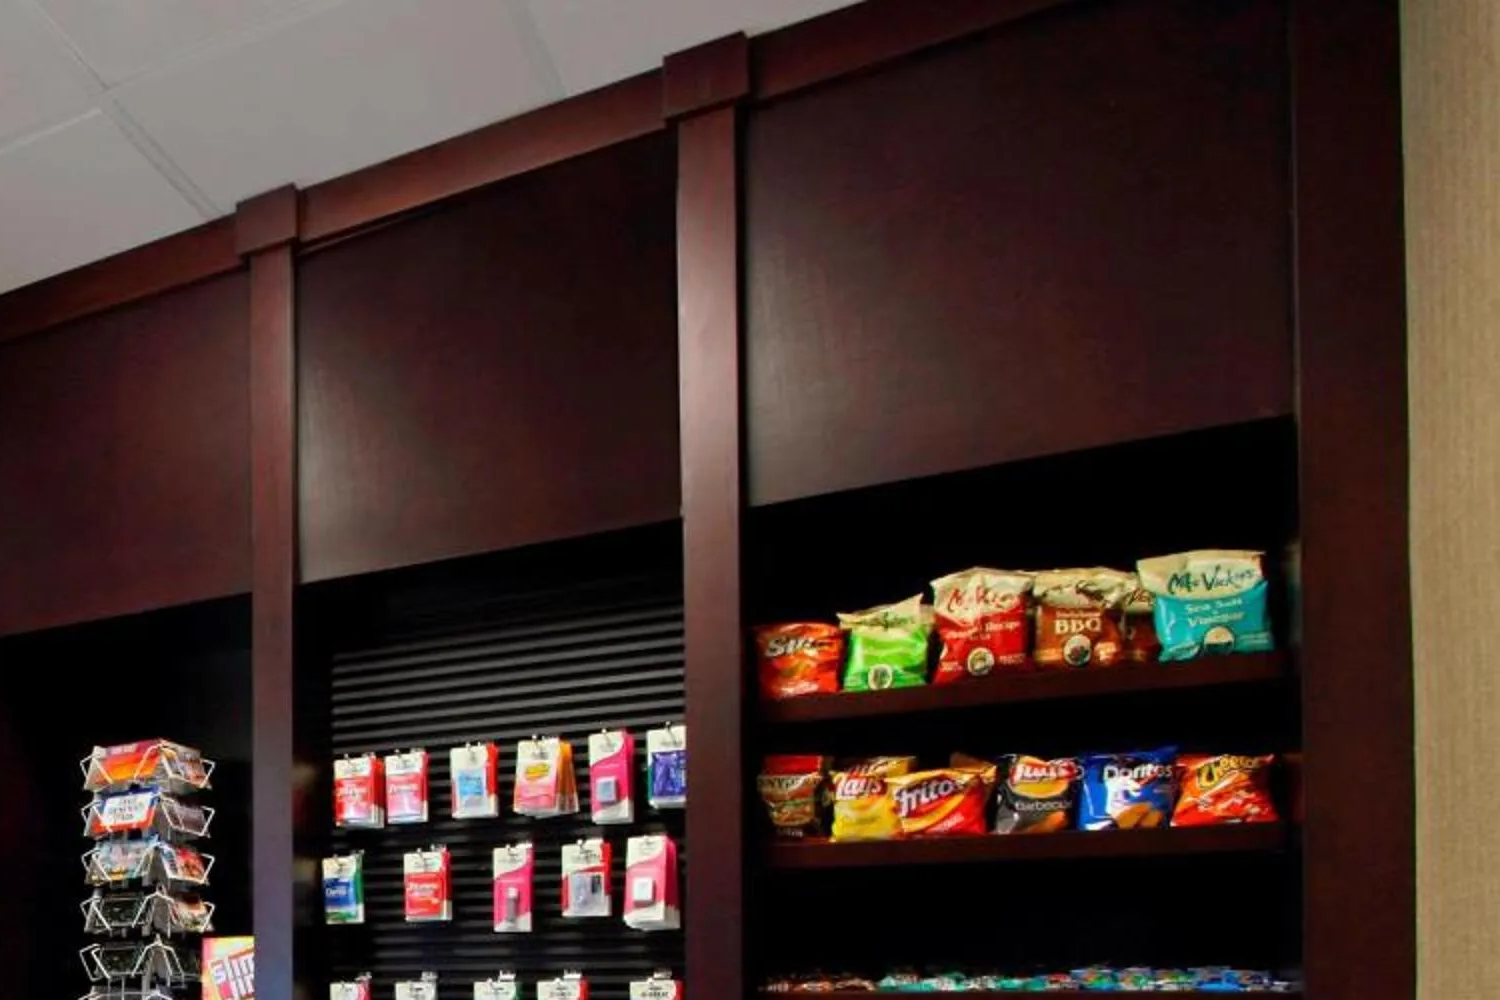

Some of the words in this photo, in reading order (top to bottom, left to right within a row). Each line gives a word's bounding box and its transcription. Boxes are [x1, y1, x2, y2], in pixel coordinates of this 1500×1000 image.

[1054, 616, 1102, 635] BBQ
[1103, 764, 1173, 781] Doritos
[893, 775, 964, 817] Fritos
